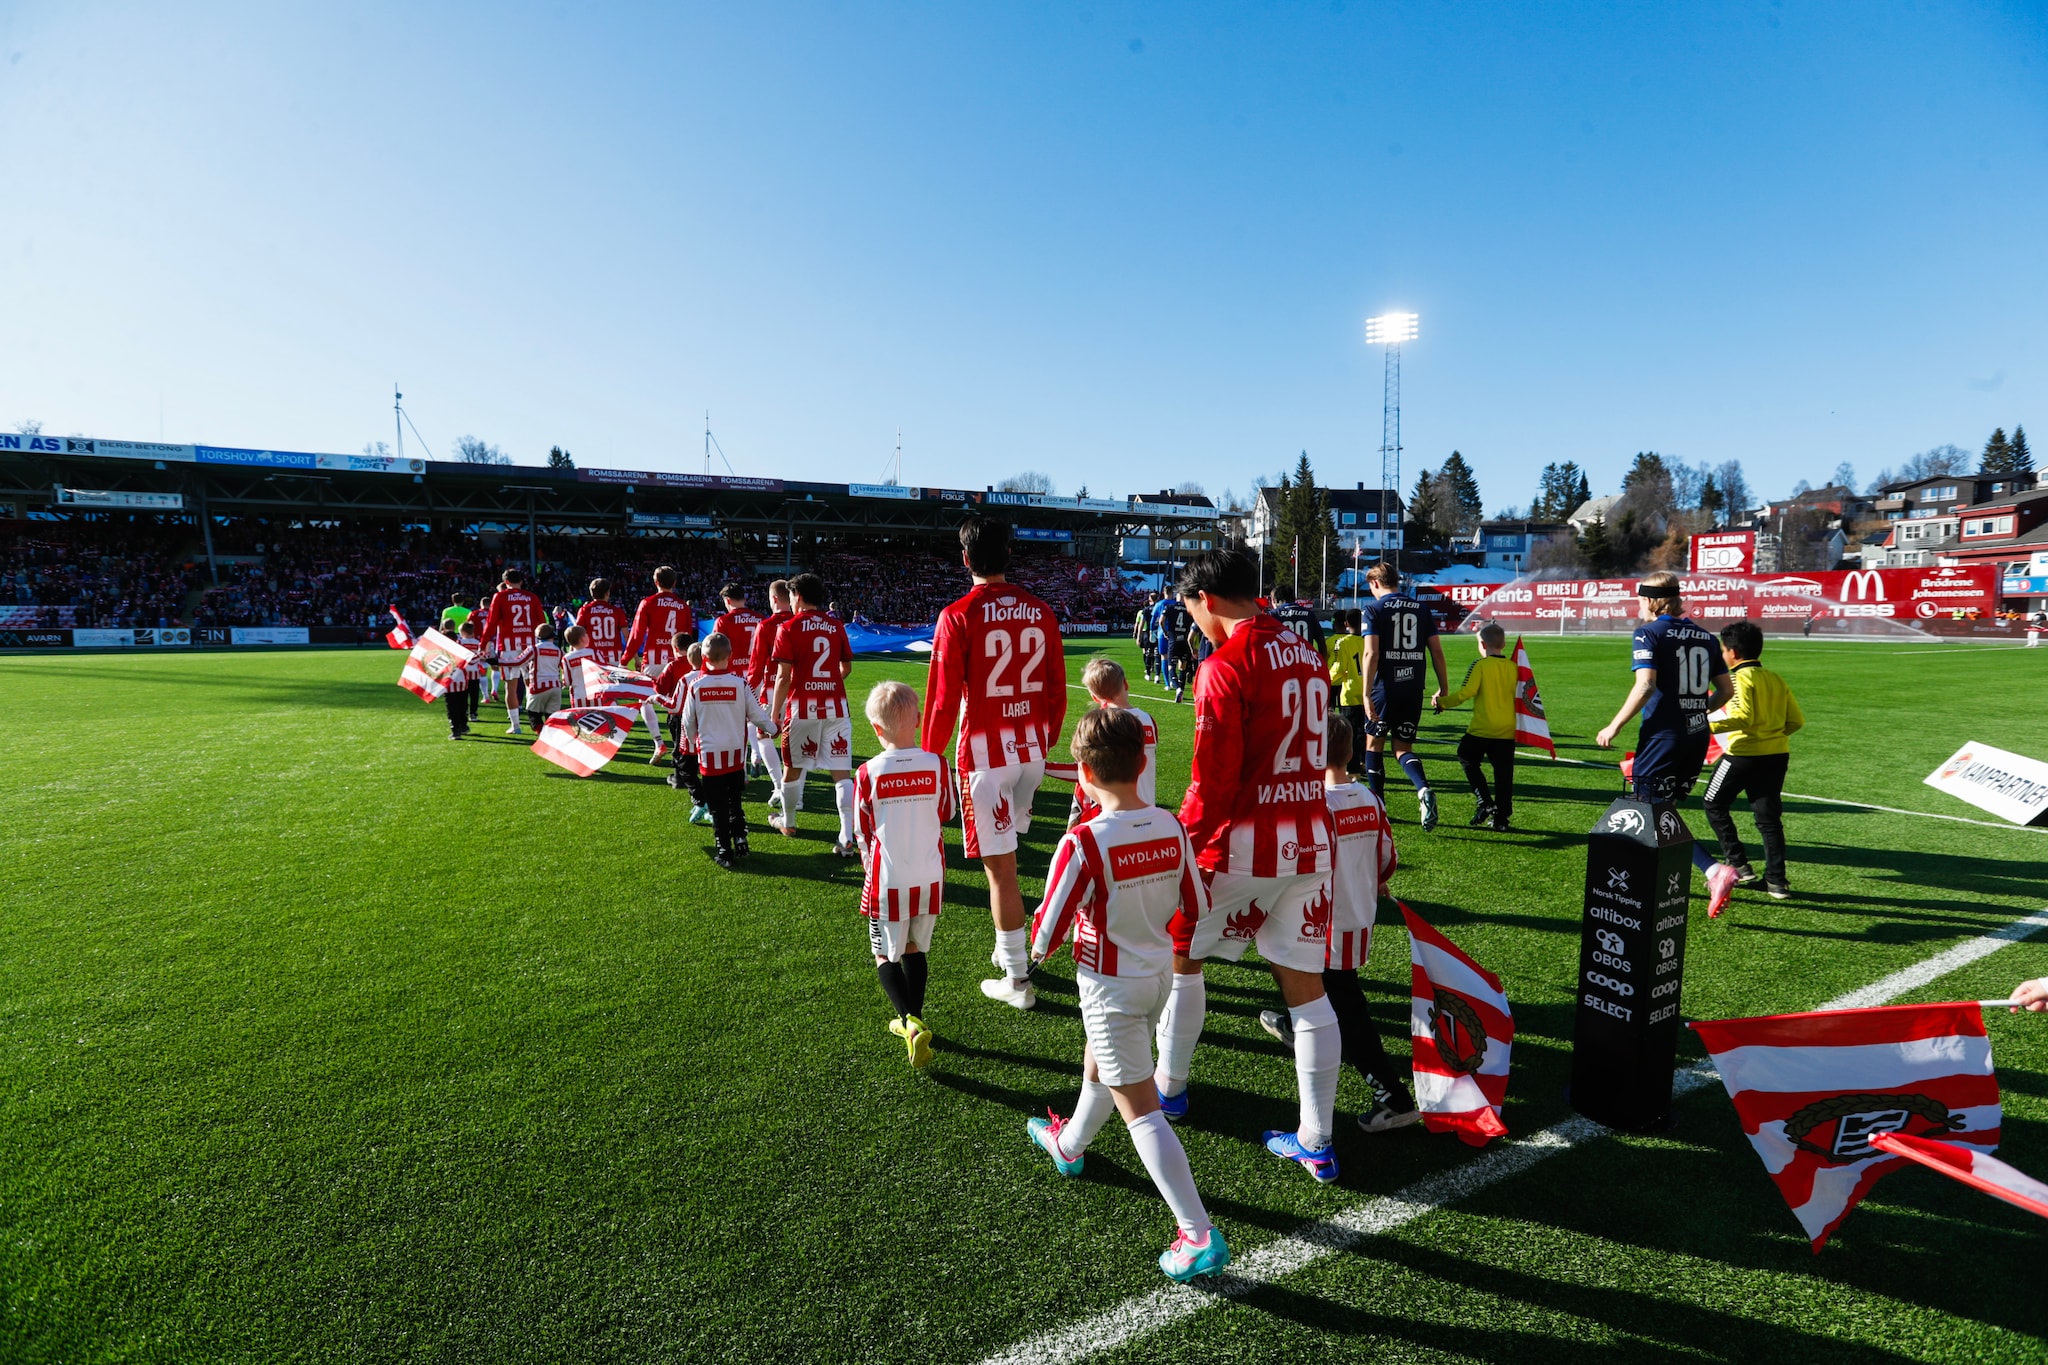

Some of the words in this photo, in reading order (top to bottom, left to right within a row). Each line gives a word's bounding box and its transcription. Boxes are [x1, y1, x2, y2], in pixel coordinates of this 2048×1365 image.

[29, 437, 60, 451] AS
[135, 443, 183, 451] BETONG
[201, 450, 255, 462] TORSHOV
[276, 455, 312, 465] SPORT
[941, 493, 965, 501] FOKUS
[988, 492, 1027, 505] HARILA
[1698, 535, 1746, 546] PELLERIN
[1701, 549, 1731, 567] 150
[1452, 586, 1489, 601] EPIC
[1537, 583, 1570, 596] HERMES
[1679, 579, 1748, 592] SAARENA
[1910, 589, 1984, 600] Johannessen
[657, 598, 684, 610] Nordlys
[1536, 607, 1576, 618] Scandic
[1761, 604, 1788, 613] Alpha
[1789, 604, 1812, 612] Nord
[1829, 604, 1895, 617] TESS
[511, 604, 532, 626] 21
[982, 602, 1042, 624] Nordlys
[1175, 611, 1184, 628] 4
[590, 616, 616, 640] 30
[665, 610, 677, 637] 4
[801, 619, 837, 634] Nordlys
[1391, 612, 1418, 650] 19
[812, 636, 831, 678] 2
[984, 626, 1046, 698] 22
[1264, 640, 1323, 671] Nordlys
[1386, 651, 1401, 660] NESS
[1396, 667, 1414, 678] MOT
[1676, 645, 1711, 696] 10
[1273, 677, 1329, 776] 29
[880, 777, 932, 790] MYDLAND
[1339, 812, 1376, 826] MYDLAND
[1117, 846, 1178, 867] MYDLAND
[1592, 887, 1614, 900] Norsk
[1614, 893, 1642, 909] Tipping
[1658, 899, 1670, 909] Norsk
[1671, 895, 1686, 906] Tipping
[1590, 907, 1641, 931] altibox
[1656, 914, 1685, 932] altibox
[1592, 950, 1632, 973] OBOS
[1656, 958, 1678, 975] OBOS
[1586, 970, 1634, 997] coop
[1651, 979, 1678, 999] coop
[1584, 993, 1632, 1022] SELECT
[1649, 1003, 1677, 1025] SELECT
